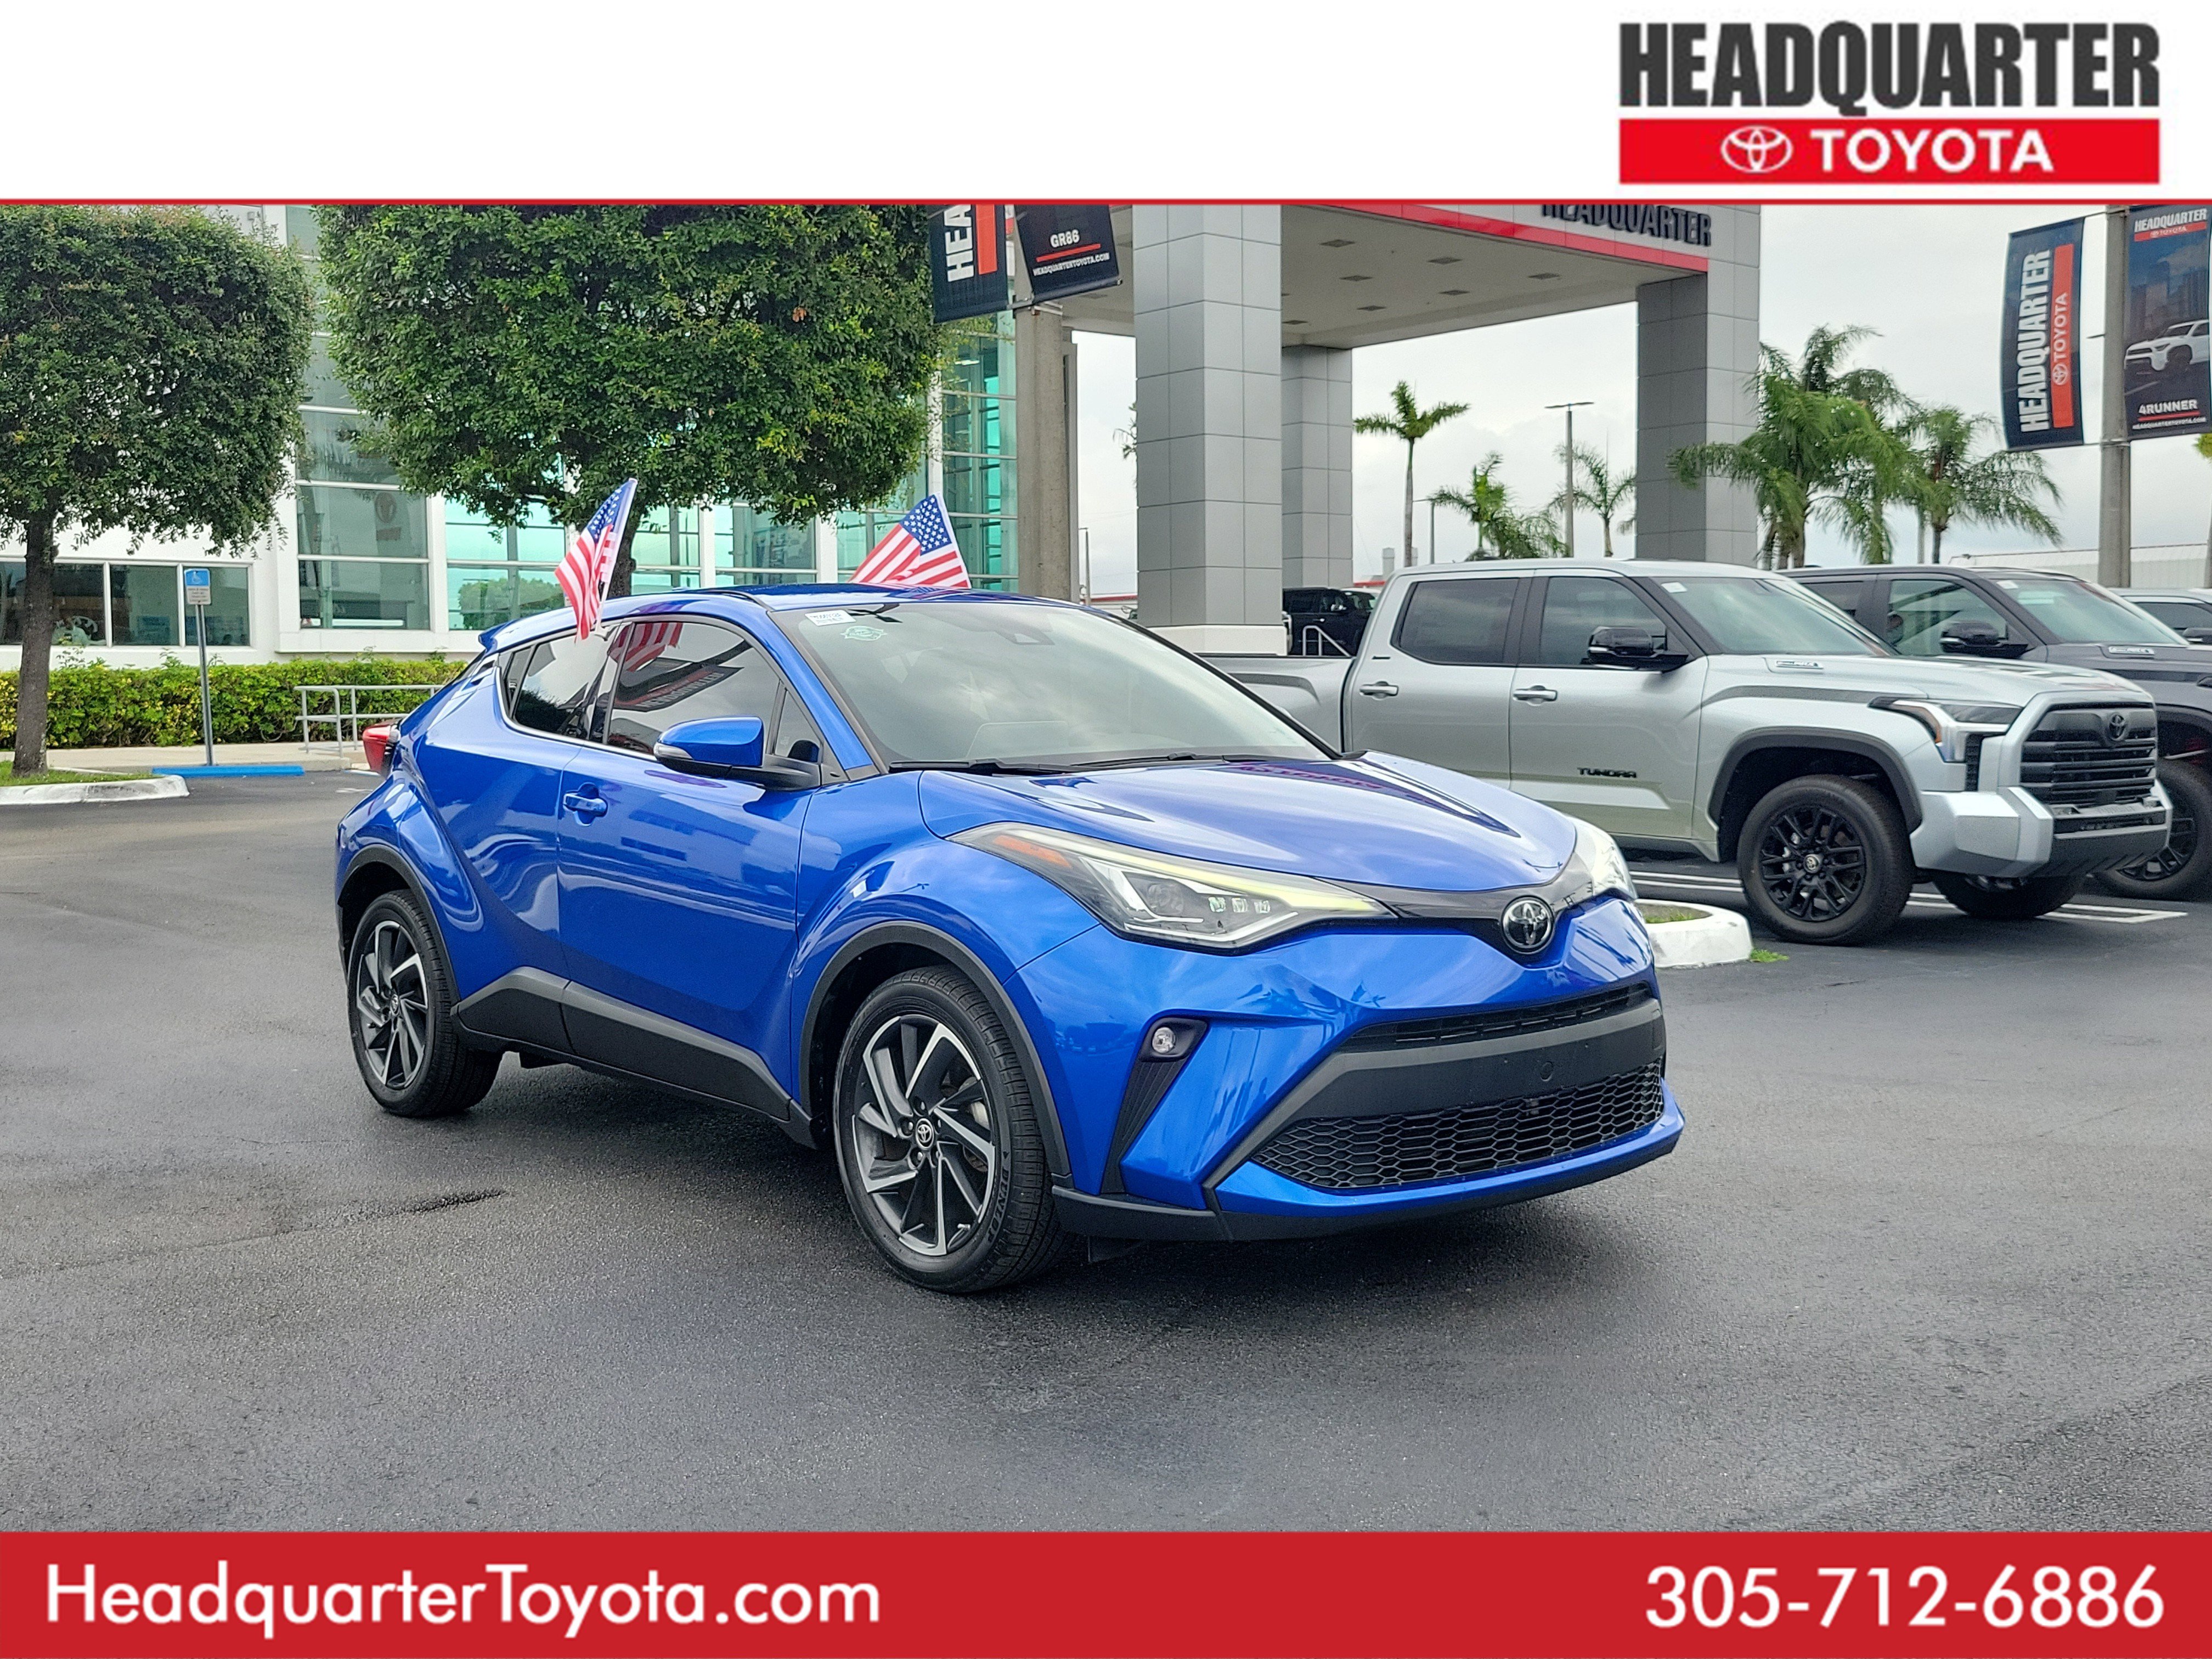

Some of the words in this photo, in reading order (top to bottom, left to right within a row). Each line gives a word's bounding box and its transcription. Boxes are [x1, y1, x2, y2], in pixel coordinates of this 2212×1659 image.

[2134, 208, 2207, 233] HEADQUARTER
[1050, 229, 1080, 248] GR86
[2159, 225, 2187, 236] TOYOTA
[2053, 292, 2069, 362] TOYOTA
[2017, 249, 2051, 433] HEADQUARTER
[2138, 399, 2198, 415] 4RUNNER
[1577, 767, 1637, 778] TUNDRA
